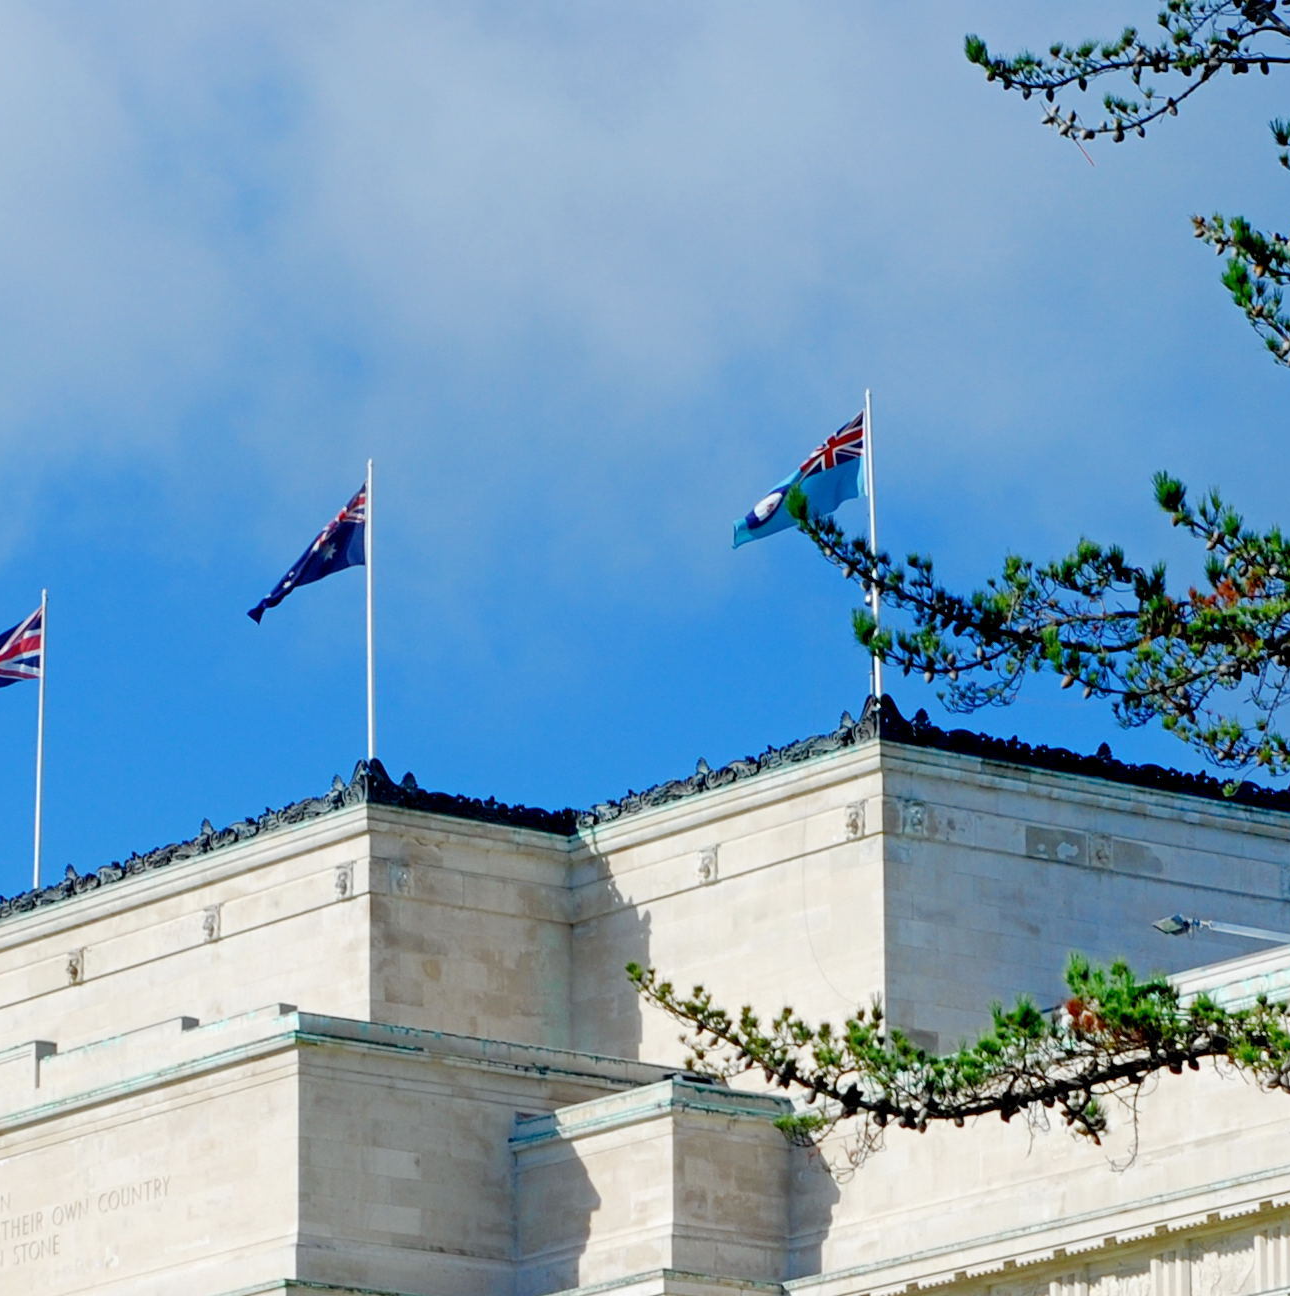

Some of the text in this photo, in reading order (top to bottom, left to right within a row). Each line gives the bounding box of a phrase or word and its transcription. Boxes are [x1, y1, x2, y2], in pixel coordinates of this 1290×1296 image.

[1, 1211, 44, 1240] THEIR
[52, 1198, 89, 1226] OWN
[98, 1175, 171, 1213] COUNTRY
[13, 1234, 60, 1265] STONE
